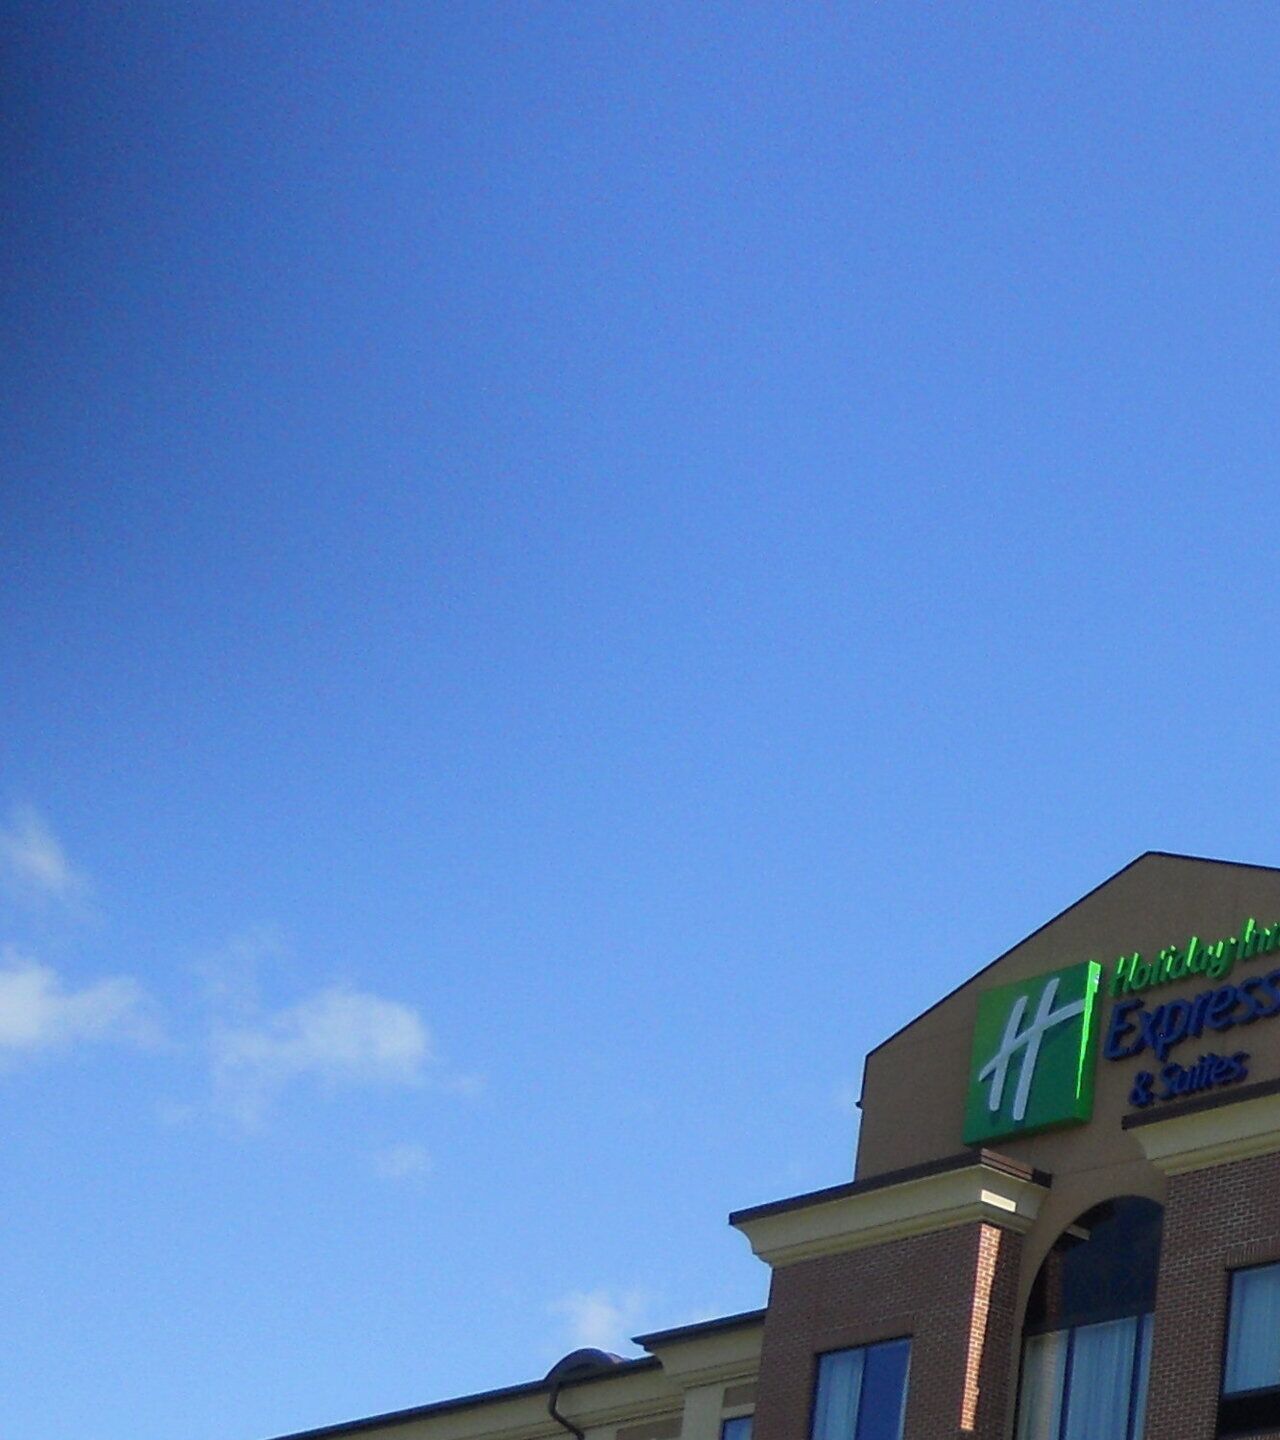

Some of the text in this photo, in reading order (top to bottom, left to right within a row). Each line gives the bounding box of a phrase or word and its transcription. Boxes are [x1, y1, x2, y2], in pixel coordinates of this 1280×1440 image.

[1108, 936, 1236, 998] Holiday
[1130, 1052, 1251, 1107] & Suites
